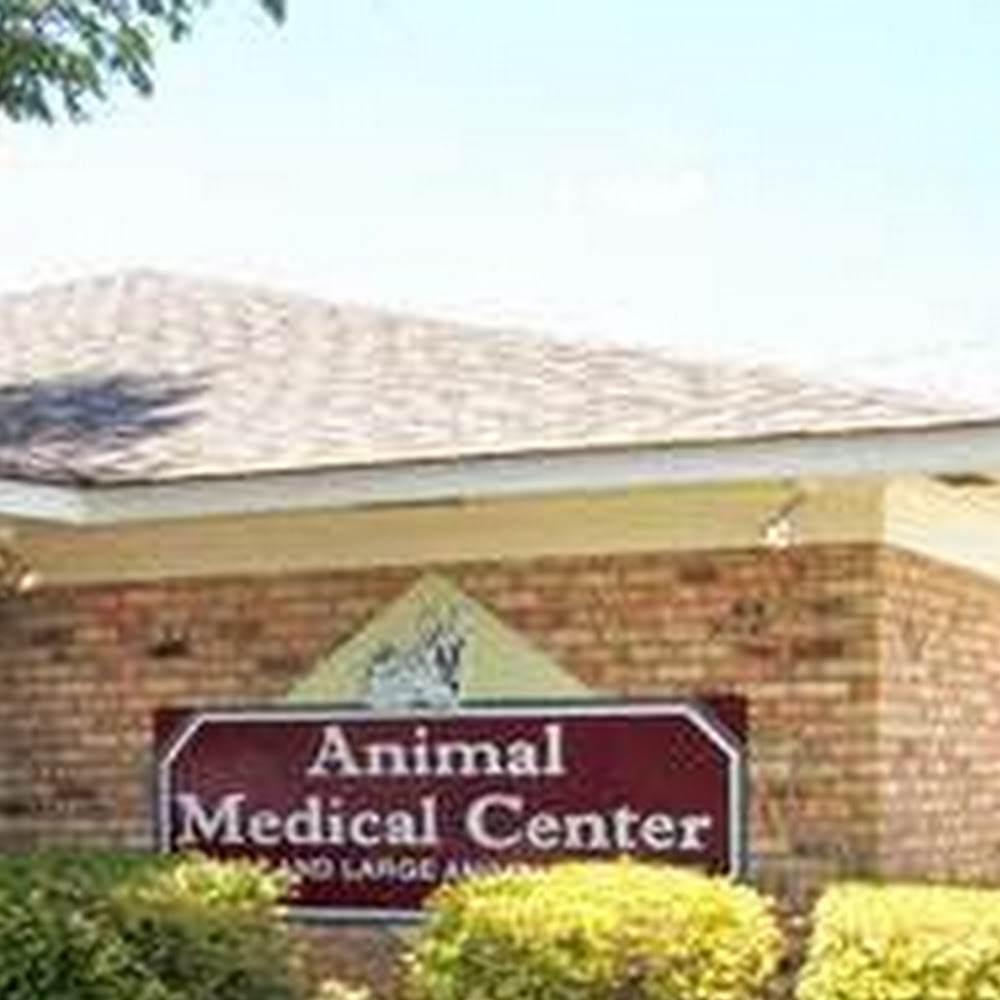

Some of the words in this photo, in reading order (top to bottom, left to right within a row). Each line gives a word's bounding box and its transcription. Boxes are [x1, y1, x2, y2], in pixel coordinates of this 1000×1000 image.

[306, 724, 567, 777] Animal
[177, 794, 437, 847] Medical
[465, 793, 713, 850] Center
[342, 859, 436, 882] LARGE
